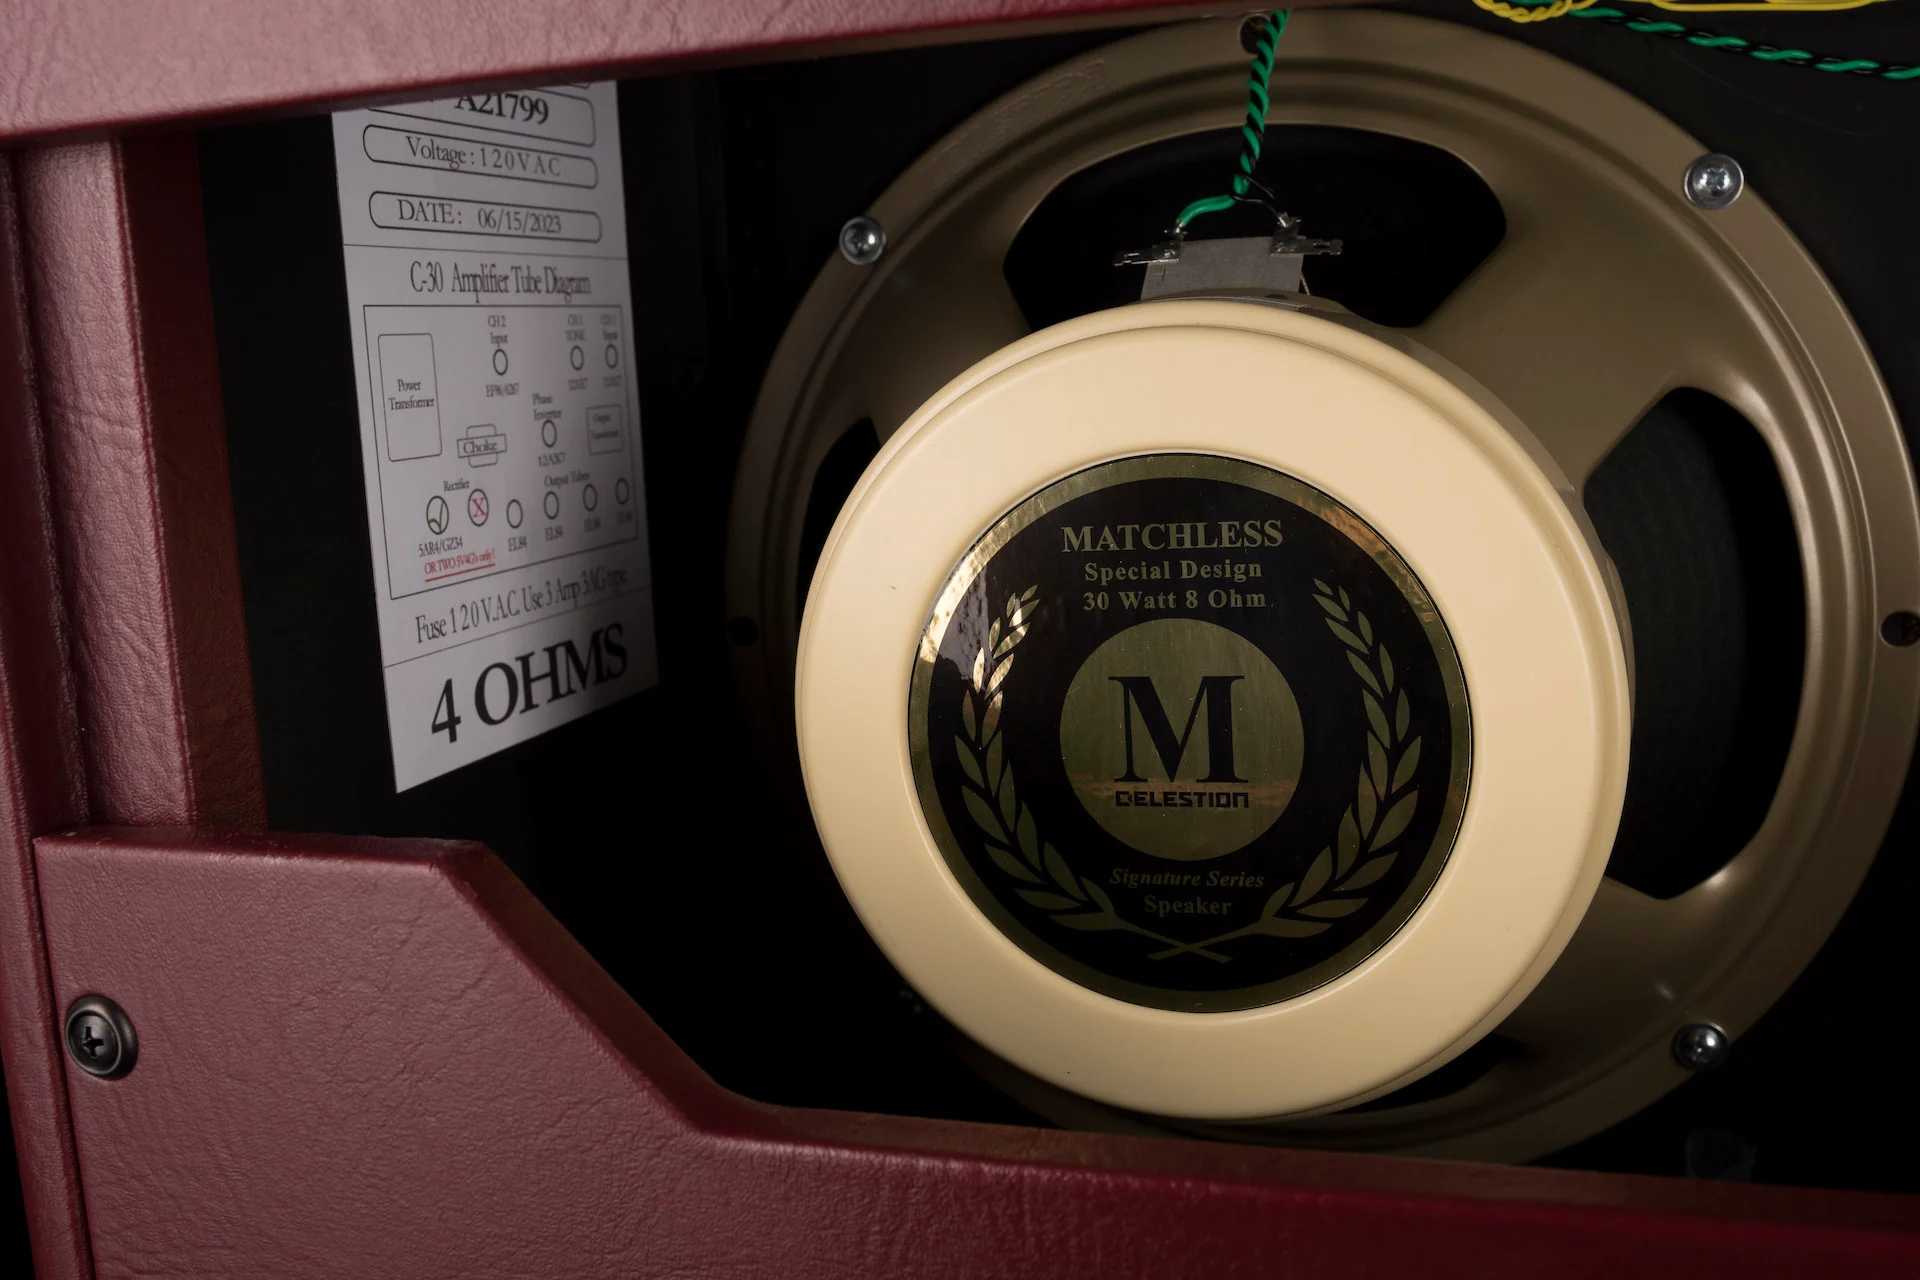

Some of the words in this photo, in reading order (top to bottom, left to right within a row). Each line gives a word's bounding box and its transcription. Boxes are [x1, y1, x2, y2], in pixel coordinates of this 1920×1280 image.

[477, 207, 562, 234] 06/15/2023
[410, 260, 444, 293] C-30
[451, 261, 509, 304] Amplifier
[511, 264, 542, 294] Tube
[543, 266, 592, 304] Diagram
[397, 378, 421, 392] Power
[388, 396, 435, 411] Transformer
[463, 439, 498, 454] Choke
[1061, 520, 1284, 553] MATCHLESS
[424, 561, 437, 575] OR
[1084, 561, 1171, 586] Special
[1180, 559, 1263, 583] Design
[1083, 592, 1110, 611] 30
[1118, 591, 1177, 610] Watt
[1185, 590, 1199, 609] 8
[1208, 589, 1267, 608] Ohm
[415, 614, 447, 643] Fuse
[522, 586, 543, 612] Use
[431, 678, 461, 743] 4
[474, 623, 627, 726] OHMS
[1108, 675, 1249, 784] M
[1115, 791, 1249, 808] CELESTION
[1109, 868, 1201, 888] Signature
[1206, 871, 1265, 888] Series
[1144, 895, 1233, 917] Speaker
